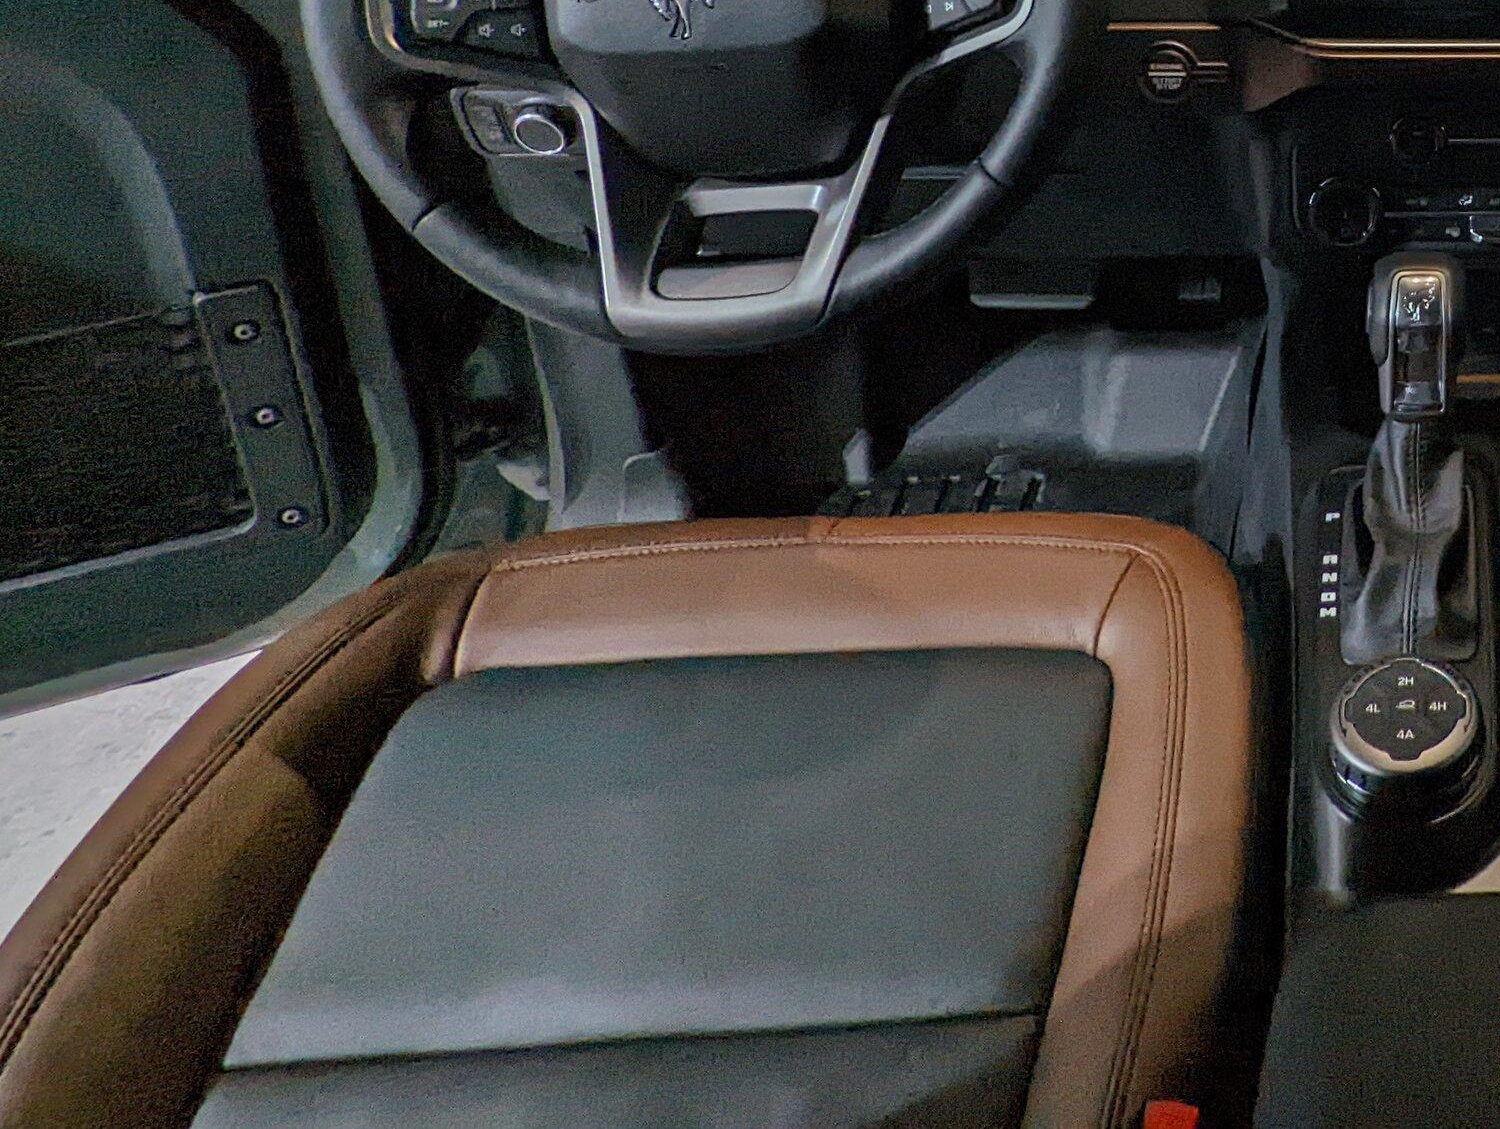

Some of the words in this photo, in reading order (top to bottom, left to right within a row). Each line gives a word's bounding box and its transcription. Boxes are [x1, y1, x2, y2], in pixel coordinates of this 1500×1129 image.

[1325, 512, 1341, 522] P
[1321, 572, 1338, 583] N
[1320, 591, 1337, 602] D
[1319, 607, 1337, 618] M
[1397, 676, 1414, 687] 2H
[1365, 703, 1381, 713] 4L
[1428, 701, 1447, 711] 4H
[1396, 729, 1415, 740] 4A
